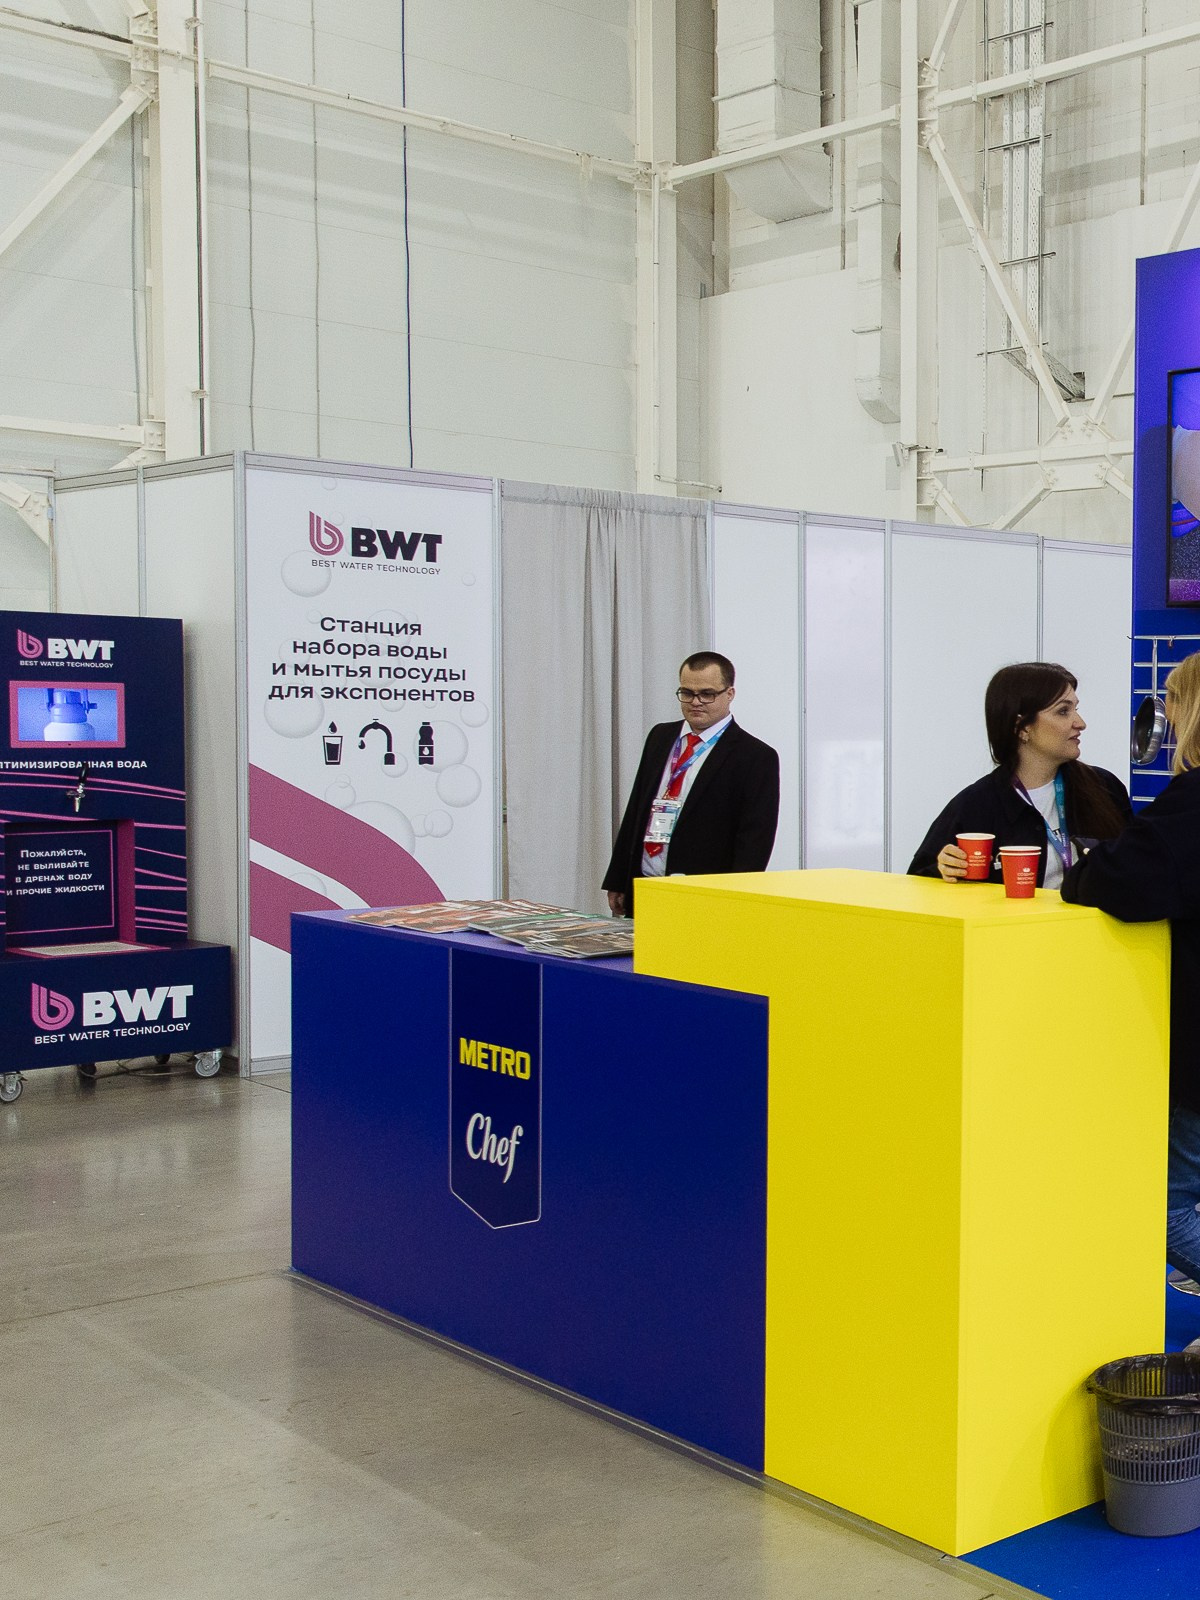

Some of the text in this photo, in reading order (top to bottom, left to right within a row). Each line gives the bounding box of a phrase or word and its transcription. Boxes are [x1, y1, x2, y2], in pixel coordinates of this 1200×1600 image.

[351, 527, 443, 563] BWT
[311, 559, 441, 575] BEST WATER TECHNOLOGY
[320, 616, 422, 636] Станция
[47, 638, 115, 661] BWT
[292, 639, 448, 661] набора воды
[66, 661, 114, 669] TECHNOLOGY
[271, 662, 466, 683] и мытья посуды
[268, 685, 475, 702] для экспонентов
[117, 760, 148, 769] ВОДА
[34, 860, 90, 871] ВЫЛИВАЙТЕ
[25, 874, 65, 884] ДРЕНАЖ
[68, 873, 93, 882] ВОДУ
[16, 887, 52, 896] ПРОЧИЕ
[55, 884, 105, 893] ЖИДКОСТИ
[82, 984, 194, 1027] BWT
[34, 1022, 191, 1045] BEST WATER TECHNOLOGY
[459, 1037, 531, 1081] METRO
[466, 1112, 524, 1184] Chef
